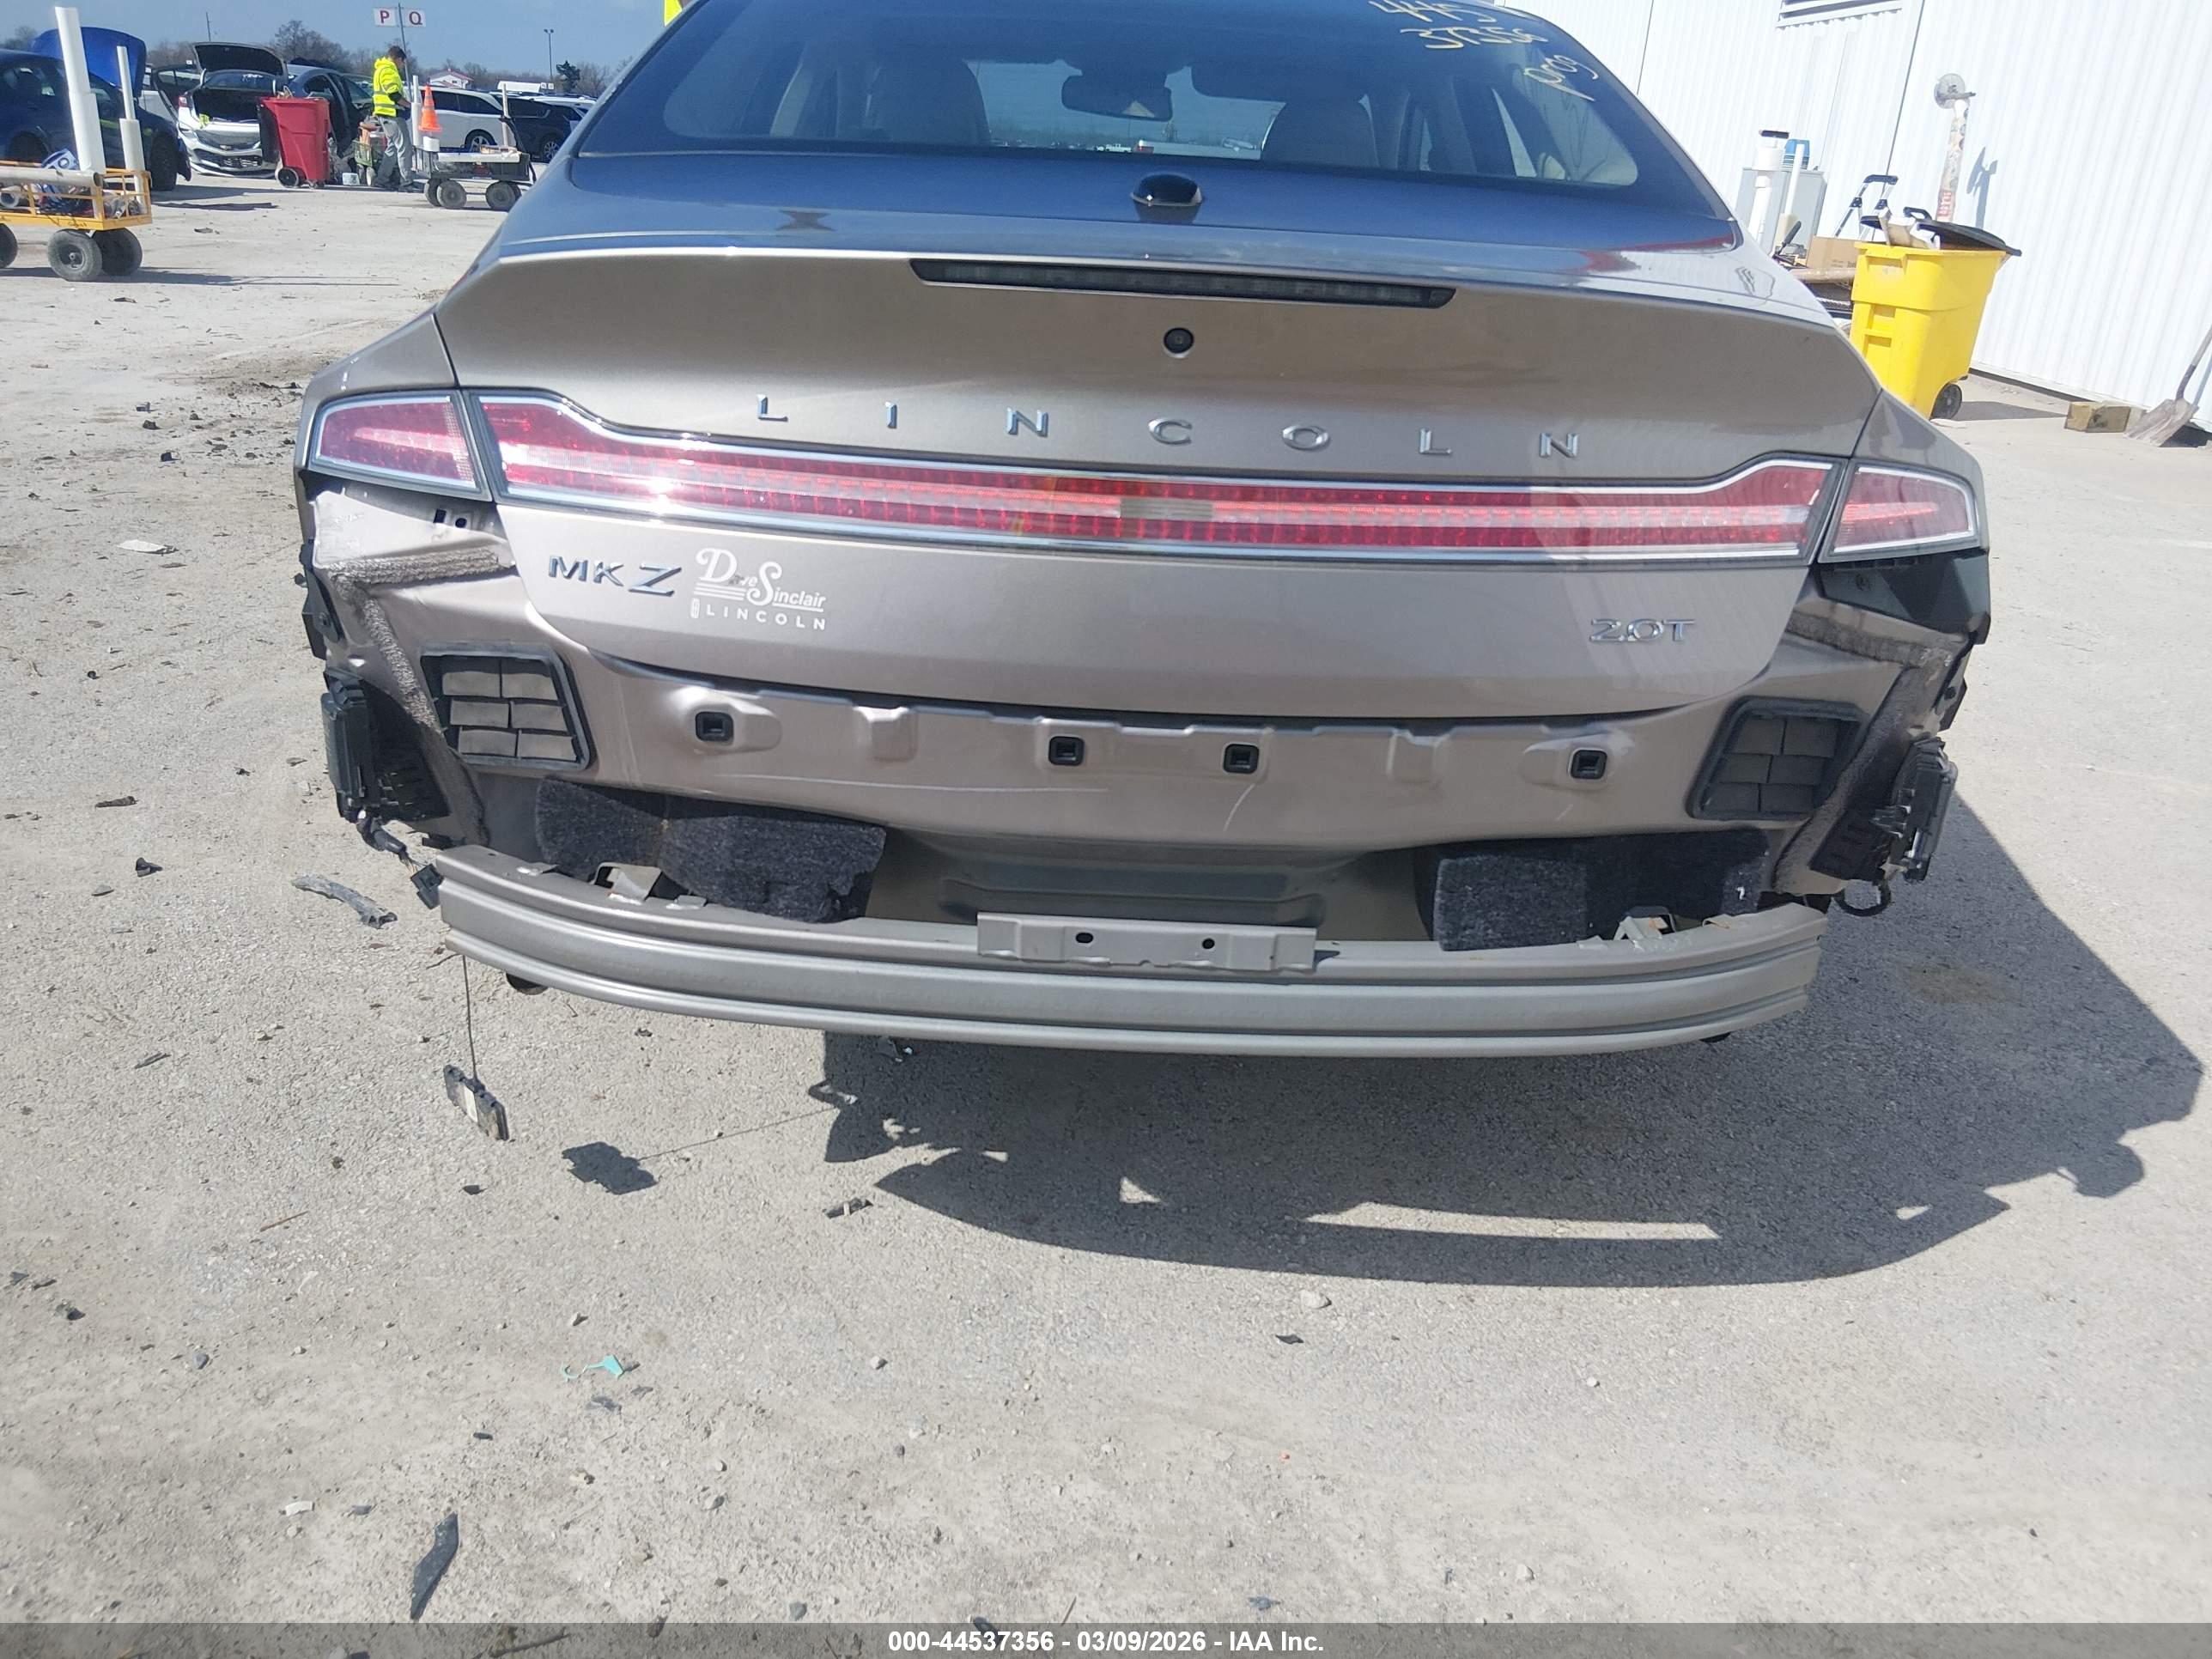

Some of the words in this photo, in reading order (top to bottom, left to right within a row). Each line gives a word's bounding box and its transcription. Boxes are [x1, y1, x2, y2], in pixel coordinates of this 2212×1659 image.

[380, 10, 390, 24] P
[409, 11, 423, 25] Q
[757, 392, 1579, 459] LINCOLN
[746, 561, 827, 608] Sinclair
[706, 605, 826, 630] LINCOLN
